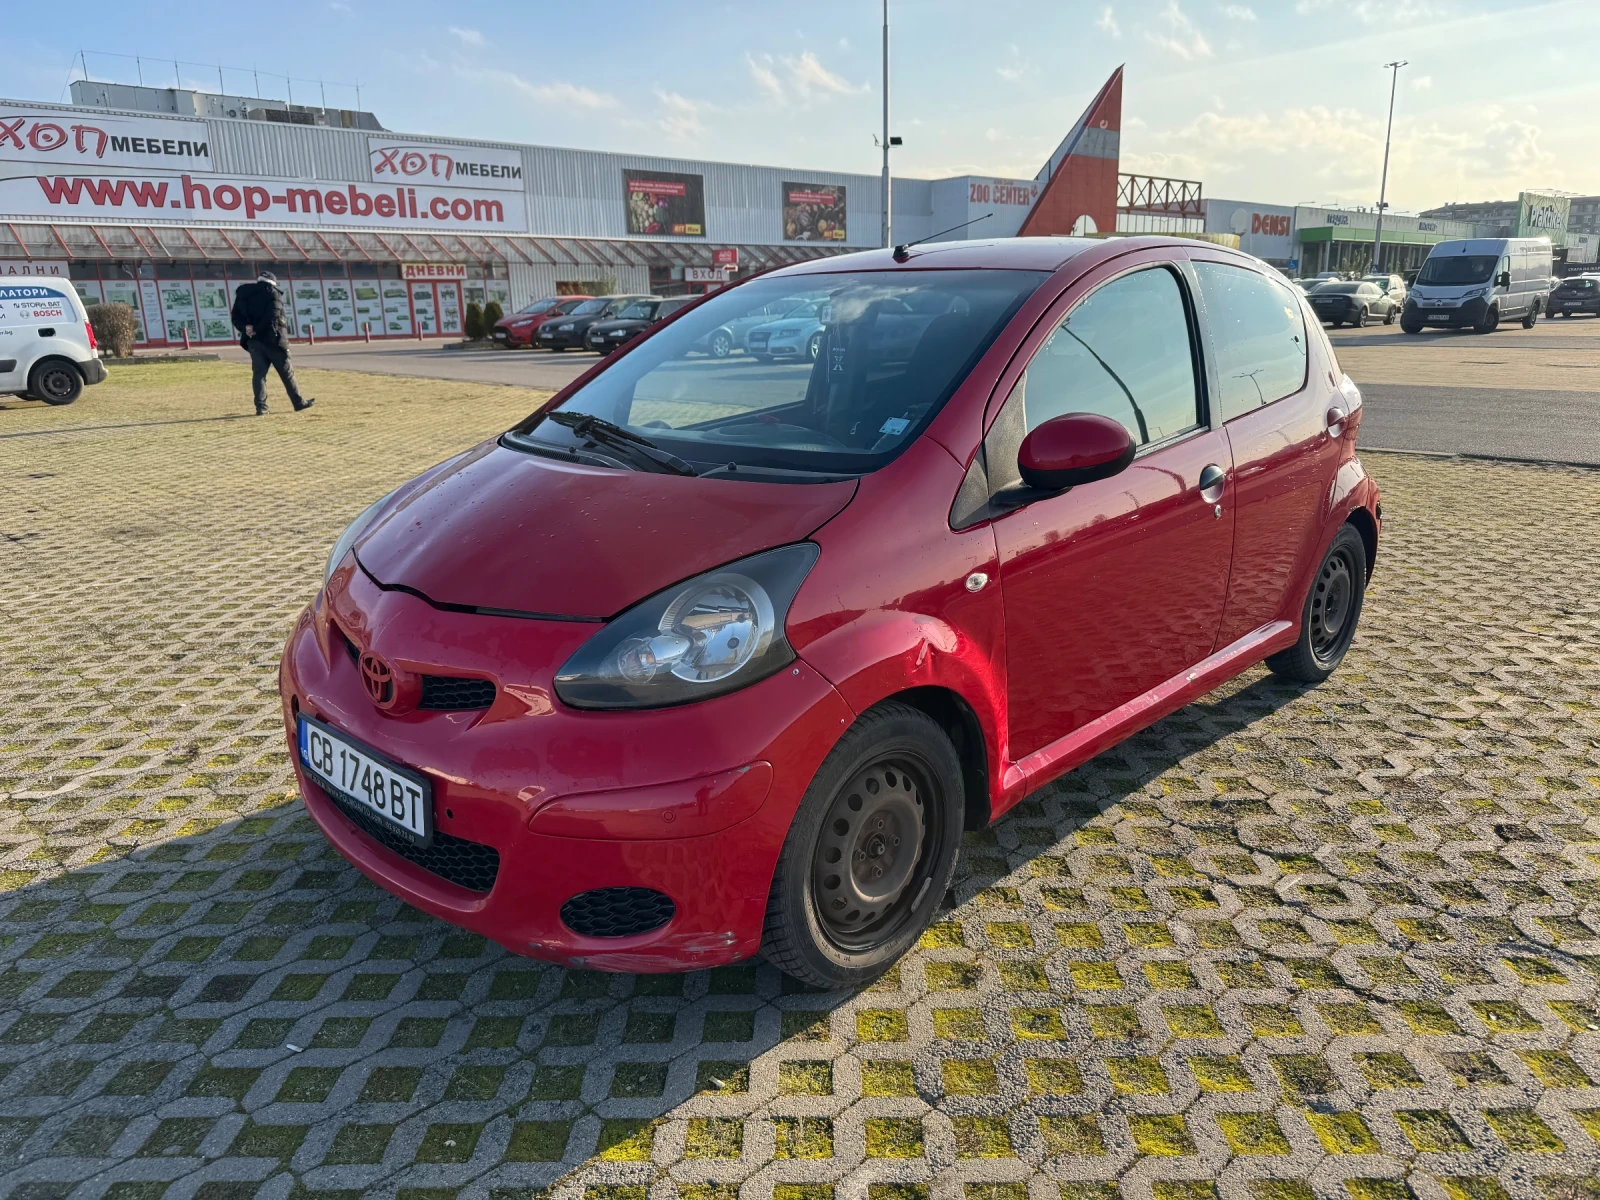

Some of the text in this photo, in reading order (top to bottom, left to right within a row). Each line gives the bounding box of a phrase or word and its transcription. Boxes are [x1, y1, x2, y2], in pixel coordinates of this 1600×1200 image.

[110, 135, 209, 158] МЕБЕЛИ
[455, 161, 522, 179] МЕБЕЛИ
[36, 174, 504, 222] www.hop-mebeli.com
[970, 183, 1030, 206] ZOO CENTER
[1251, 212, 1292, 237] DENSI
[0, 265, 60, 275] АЛНИ
[405, 264, 466, 277] ДНЕВНИ
[693, 268, 723, 280] ВХОД
[33, 309, 63, 318] BOSCH
